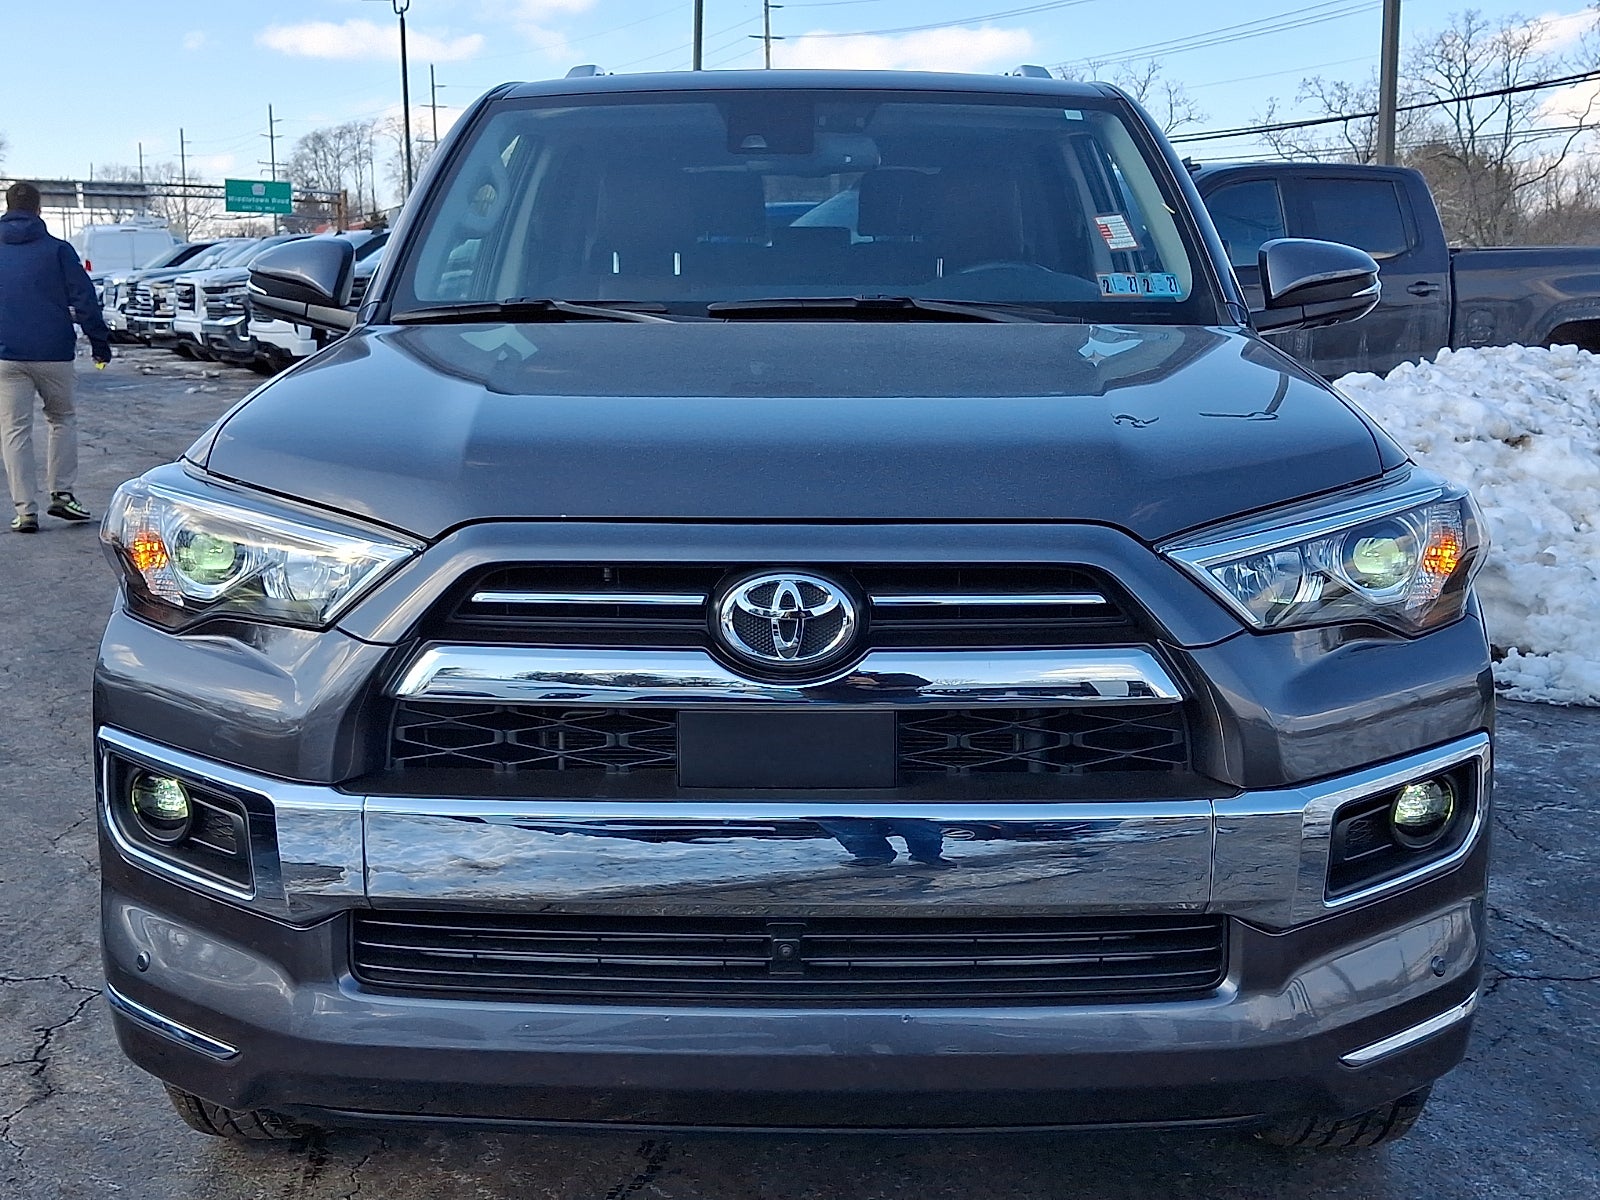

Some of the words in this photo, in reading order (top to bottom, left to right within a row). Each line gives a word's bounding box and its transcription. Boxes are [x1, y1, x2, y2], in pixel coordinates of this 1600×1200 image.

[1102, 279, 1112, 294] 2
[1126, 276, 1139, 293] 27
[1143, 278, 1153, 293] 2
[1166, 276, 1178, 293] 27
